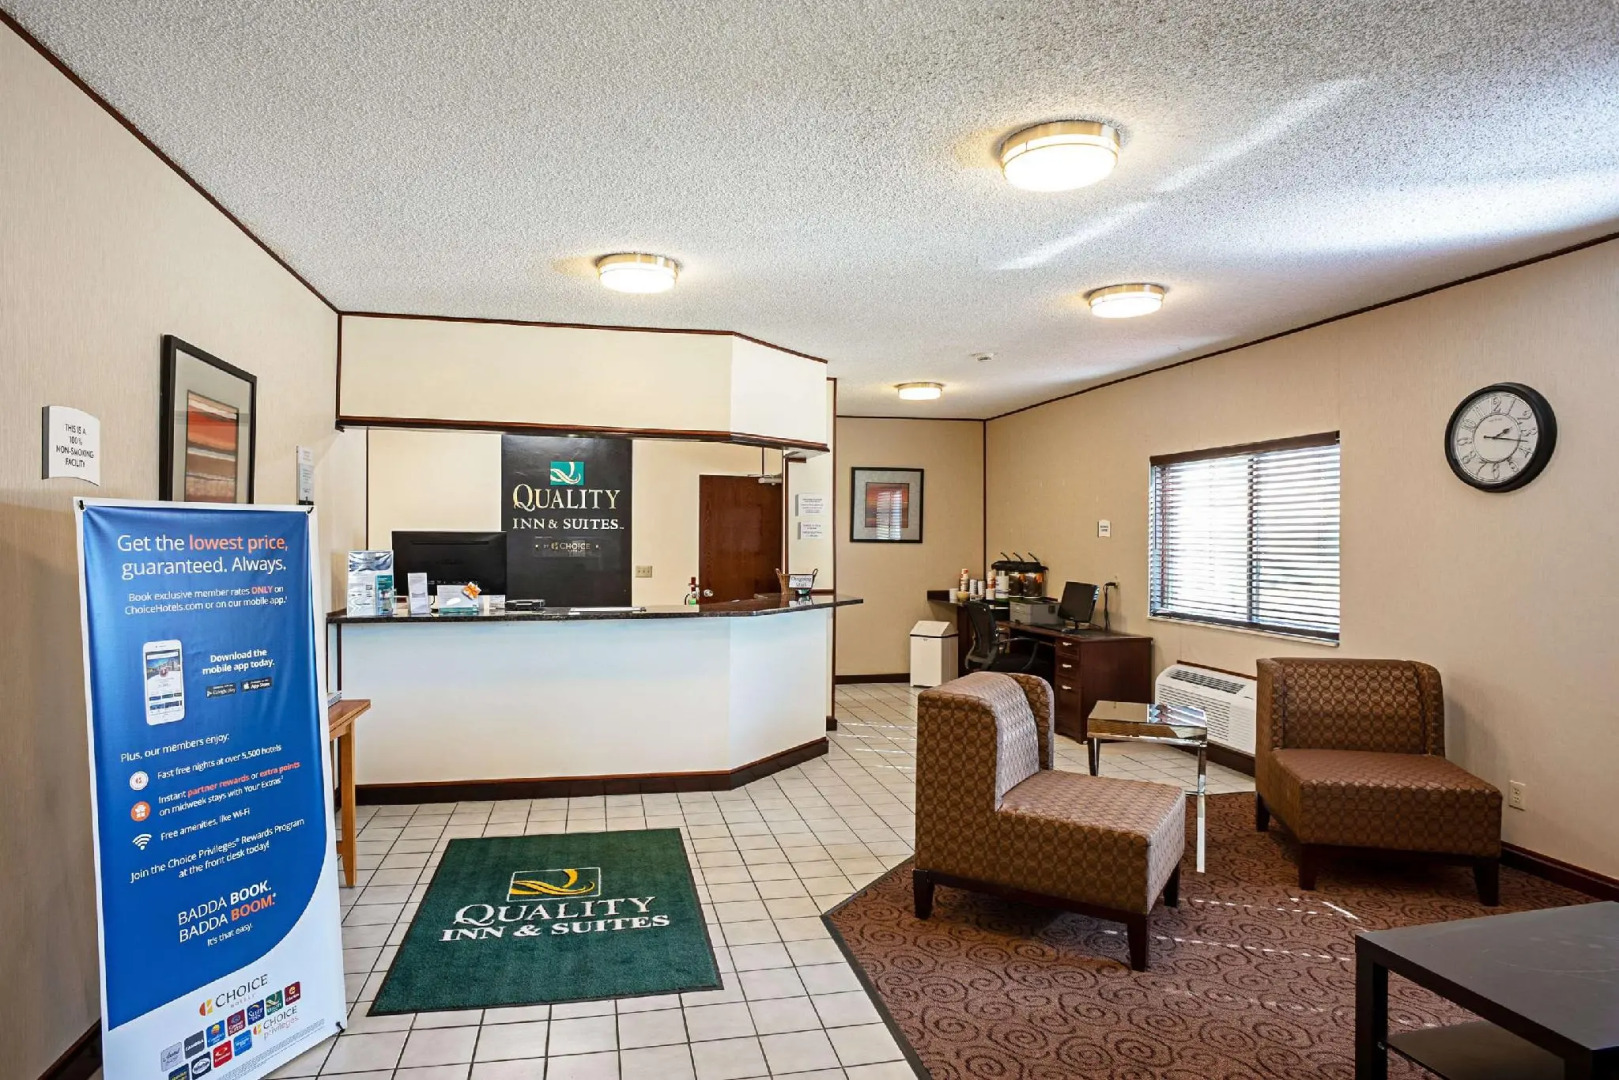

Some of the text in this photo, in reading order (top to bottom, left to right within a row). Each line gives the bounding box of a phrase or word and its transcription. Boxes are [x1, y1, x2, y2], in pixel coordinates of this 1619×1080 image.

[65, 423, 76, 433] THIS
[77, 426, 82, 435] IS
[69, 435, 82, 445] 100%
[56, 445, 94, 458] NON-SMOKING
[65, 457, 85, 468] FACILITY
[512, 483, 621, 512] QUALITY
[513, 518, 619, 530] INN & SUITES
[117, 534, 288, 554] Get the lowest price,
[560, 542, 591, 550] CHOICE
[121, 557, 286, 581] guaranteed. Always.
[125, 603, 203, 615] ChoiceHotels.com
[205, 602, 214, 610] or
[215, 601, 227, 609] on
[228, 600, 242, 608] our
[243, 597, 269, 607] mobile
[129, 593, 152, 602] Book
[154, 591, 193, 601] exclusive
[194, 588, 229, 598] member
[230, 588, 250, 597] rates
[251, 586, 273, 595] ONLY
[202, 659, 275, 675] mobile app today.
[210, 649, 268, 663] Download the
[120, 752, 143, 762] Plus,
[144, 748, 160, 757] our
[162, 738, 204, 753] members
[157, 744, 282, 779] Fast free nights at over 5,500 hotels
[158, 762, 301, 804] Instant partner rewards or extra points
[159, 808, 170, 817] on
[172, 797, 206, 813] midweek
[207, 792, 227, 803] stays
[228, 788, 243, 798] with
[244, 783, 261, 793] Your
[160, 807, 250, 841] Free amenities, like Wi-Fi
[130, 868, 149, 883] Join
[151, 863, 166, 874] the
[168, 853, 197, 868] Choice
[241, 828, 273, 844] Rewards
[274, 818, 305, 834] Program
[178, 840, 270, 878] at the front desk today!
[178, 880, 272, 926] BADDA BOOK.
[453, 896, 655, 927] QUALITY
[179, 914, 229, 943] BADDA
[219, 930, 235, 941] that
[438, 914, 671, 942] INN & SUITES
[215, 974, 268, 1008] CHOICE
[263, 1005, 298, 1030] CHOICE
